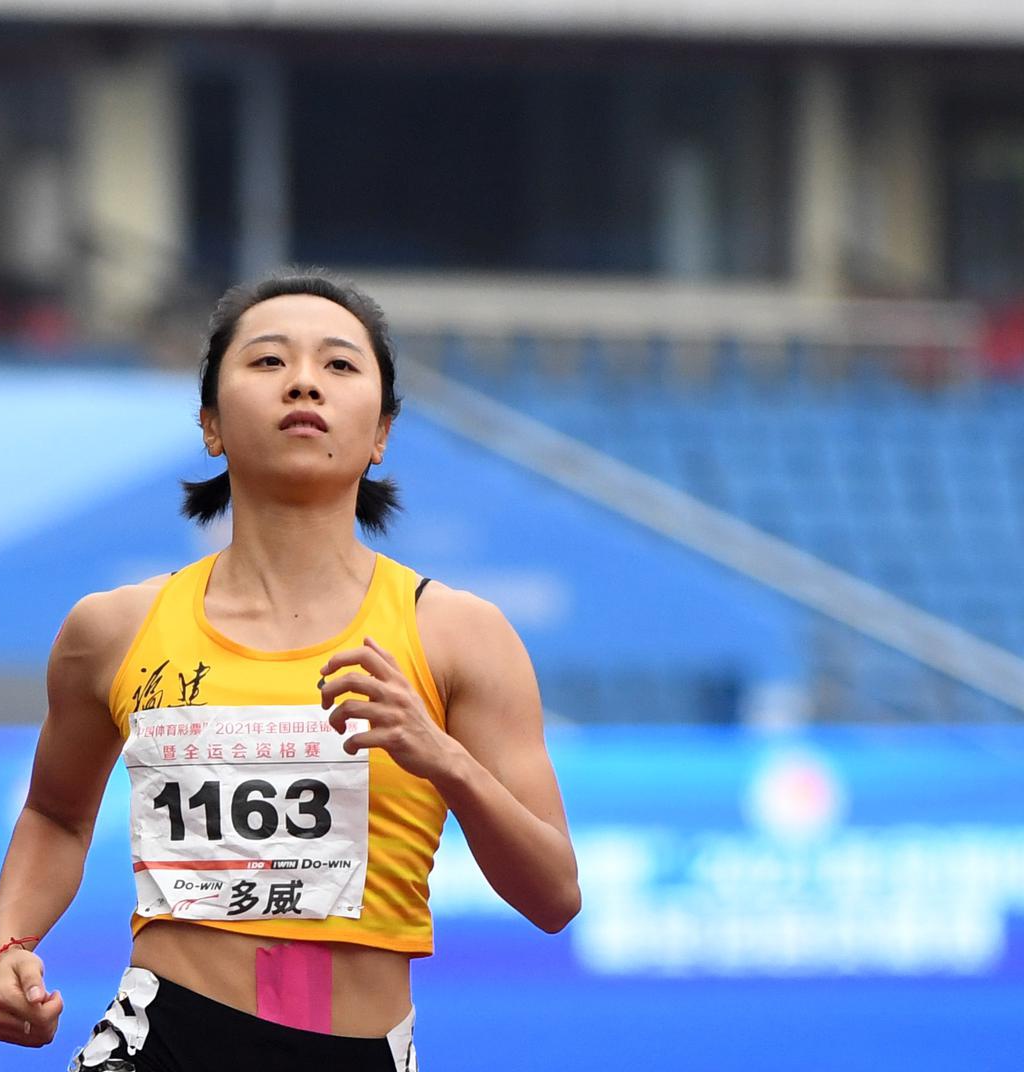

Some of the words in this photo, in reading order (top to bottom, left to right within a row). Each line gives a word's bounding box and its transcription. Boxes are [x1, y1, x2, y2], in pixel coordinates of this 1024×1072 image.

[163, 742, 320, 761] 暨全运会资格赛
[153, 779, 332, 841] 1163
[226, 880, 304, 916] 多威
